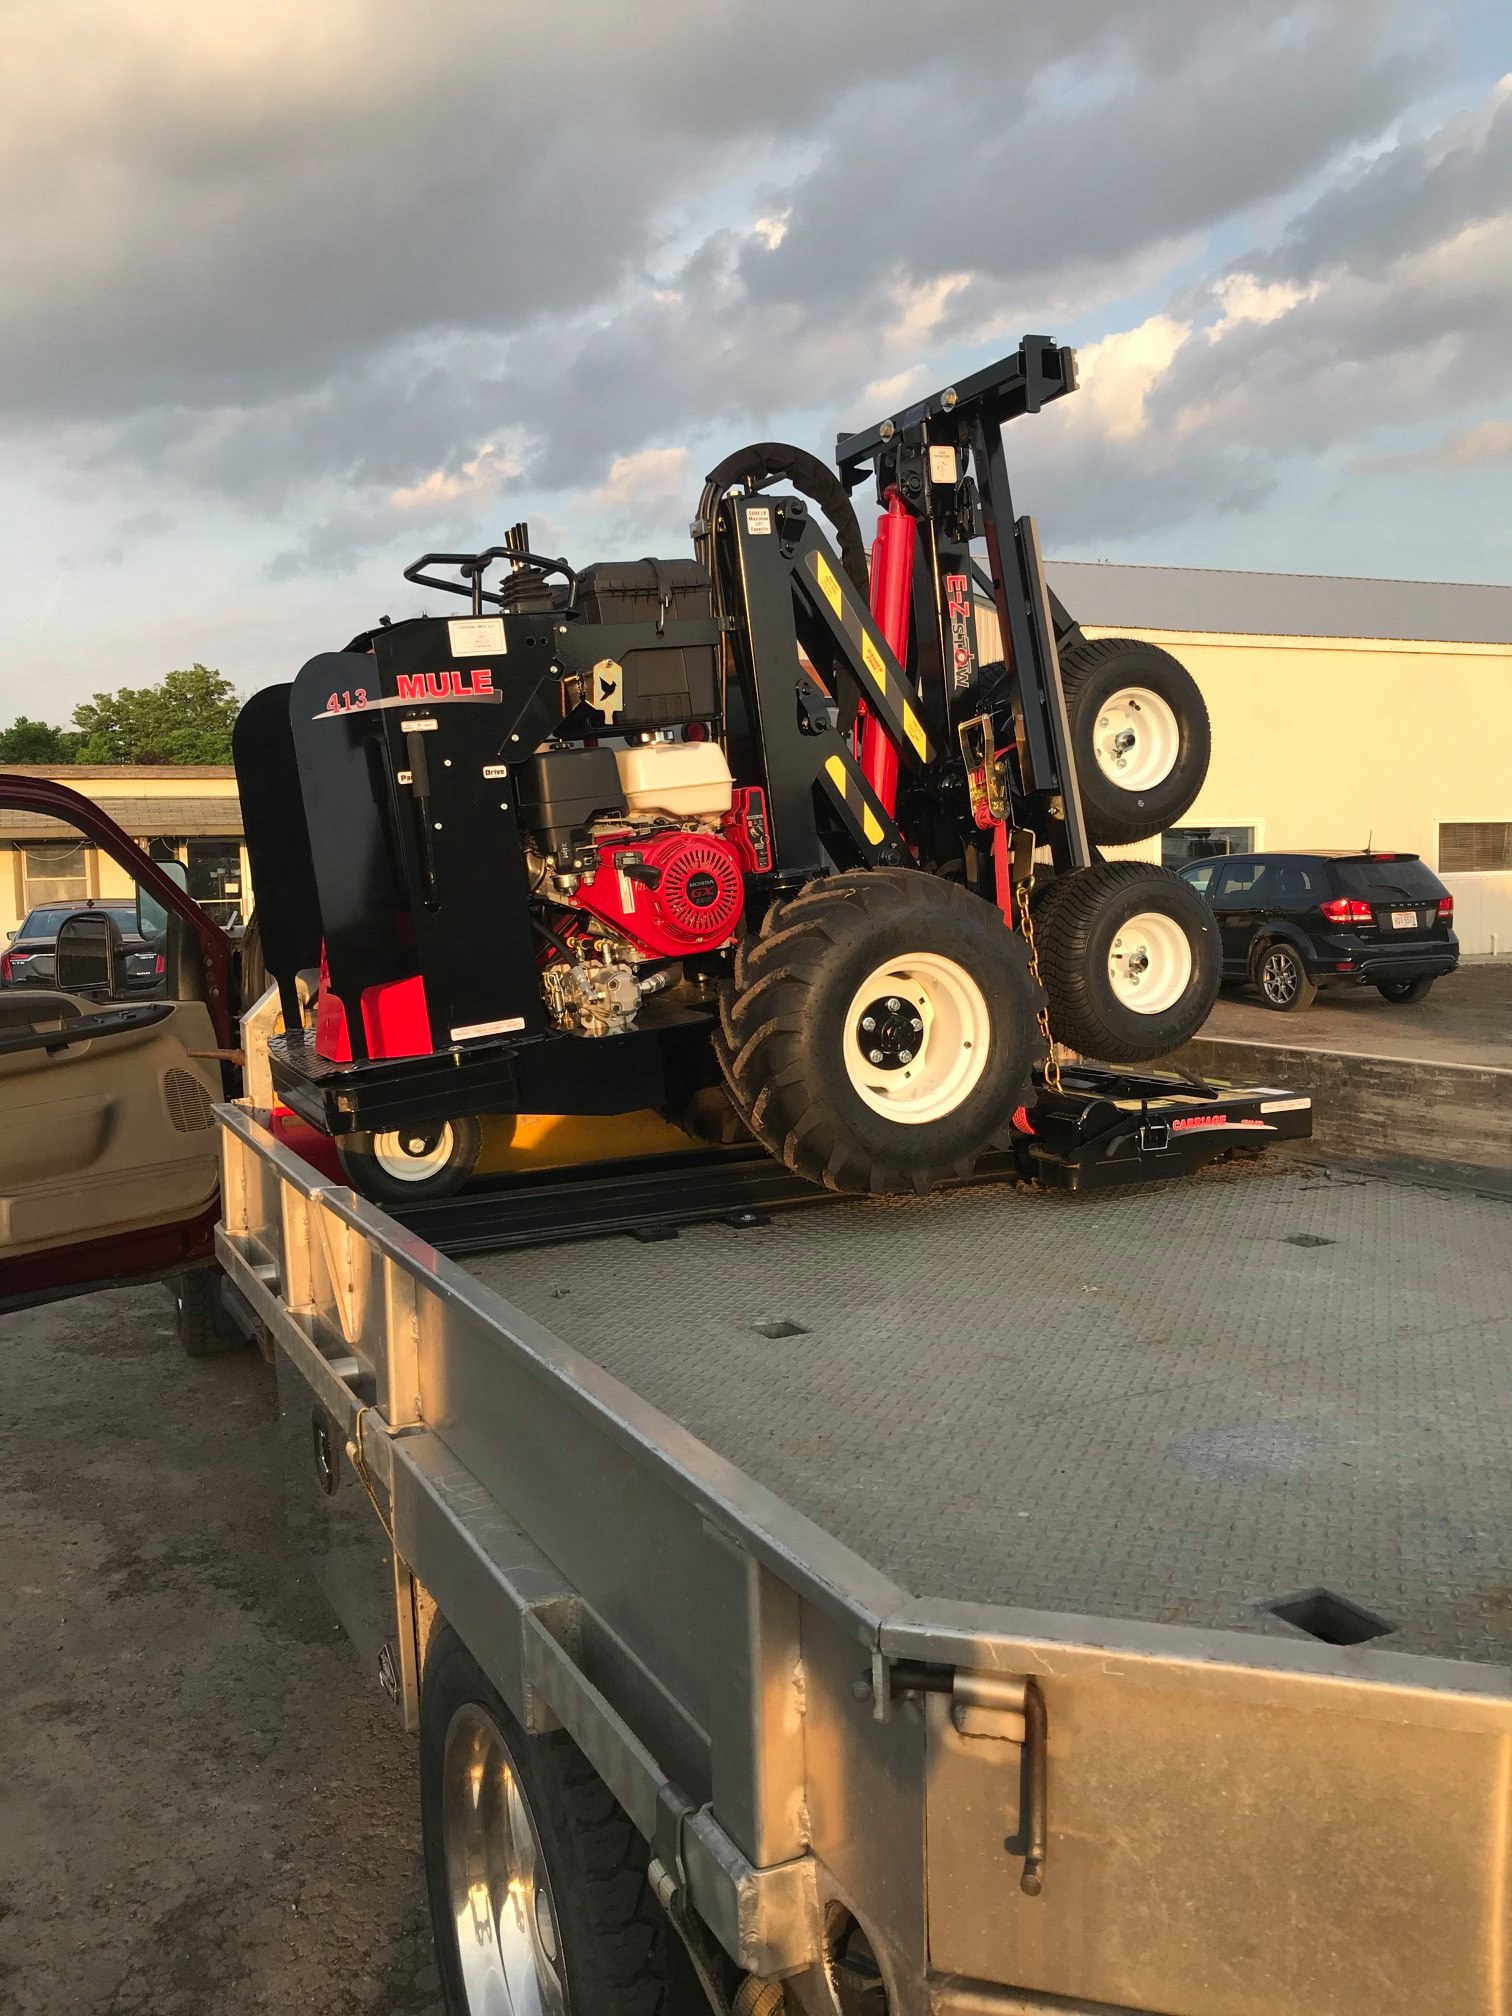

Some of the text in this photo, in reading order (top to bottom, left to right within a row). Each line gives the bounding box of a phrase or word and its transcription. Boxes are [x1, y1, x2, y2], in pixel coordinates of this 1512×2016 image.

[947, 575, 970, 618] E-Z
[396, 669, 494, 700] MULE
[326, 688, 368, 714] 413
[485, 768, 505, 777] Drive
[689, 879, 715, 888] HONDA
[690, 885, 715, 898] GX
[1172, 1114, 1227, 1131] CARRIAGE
